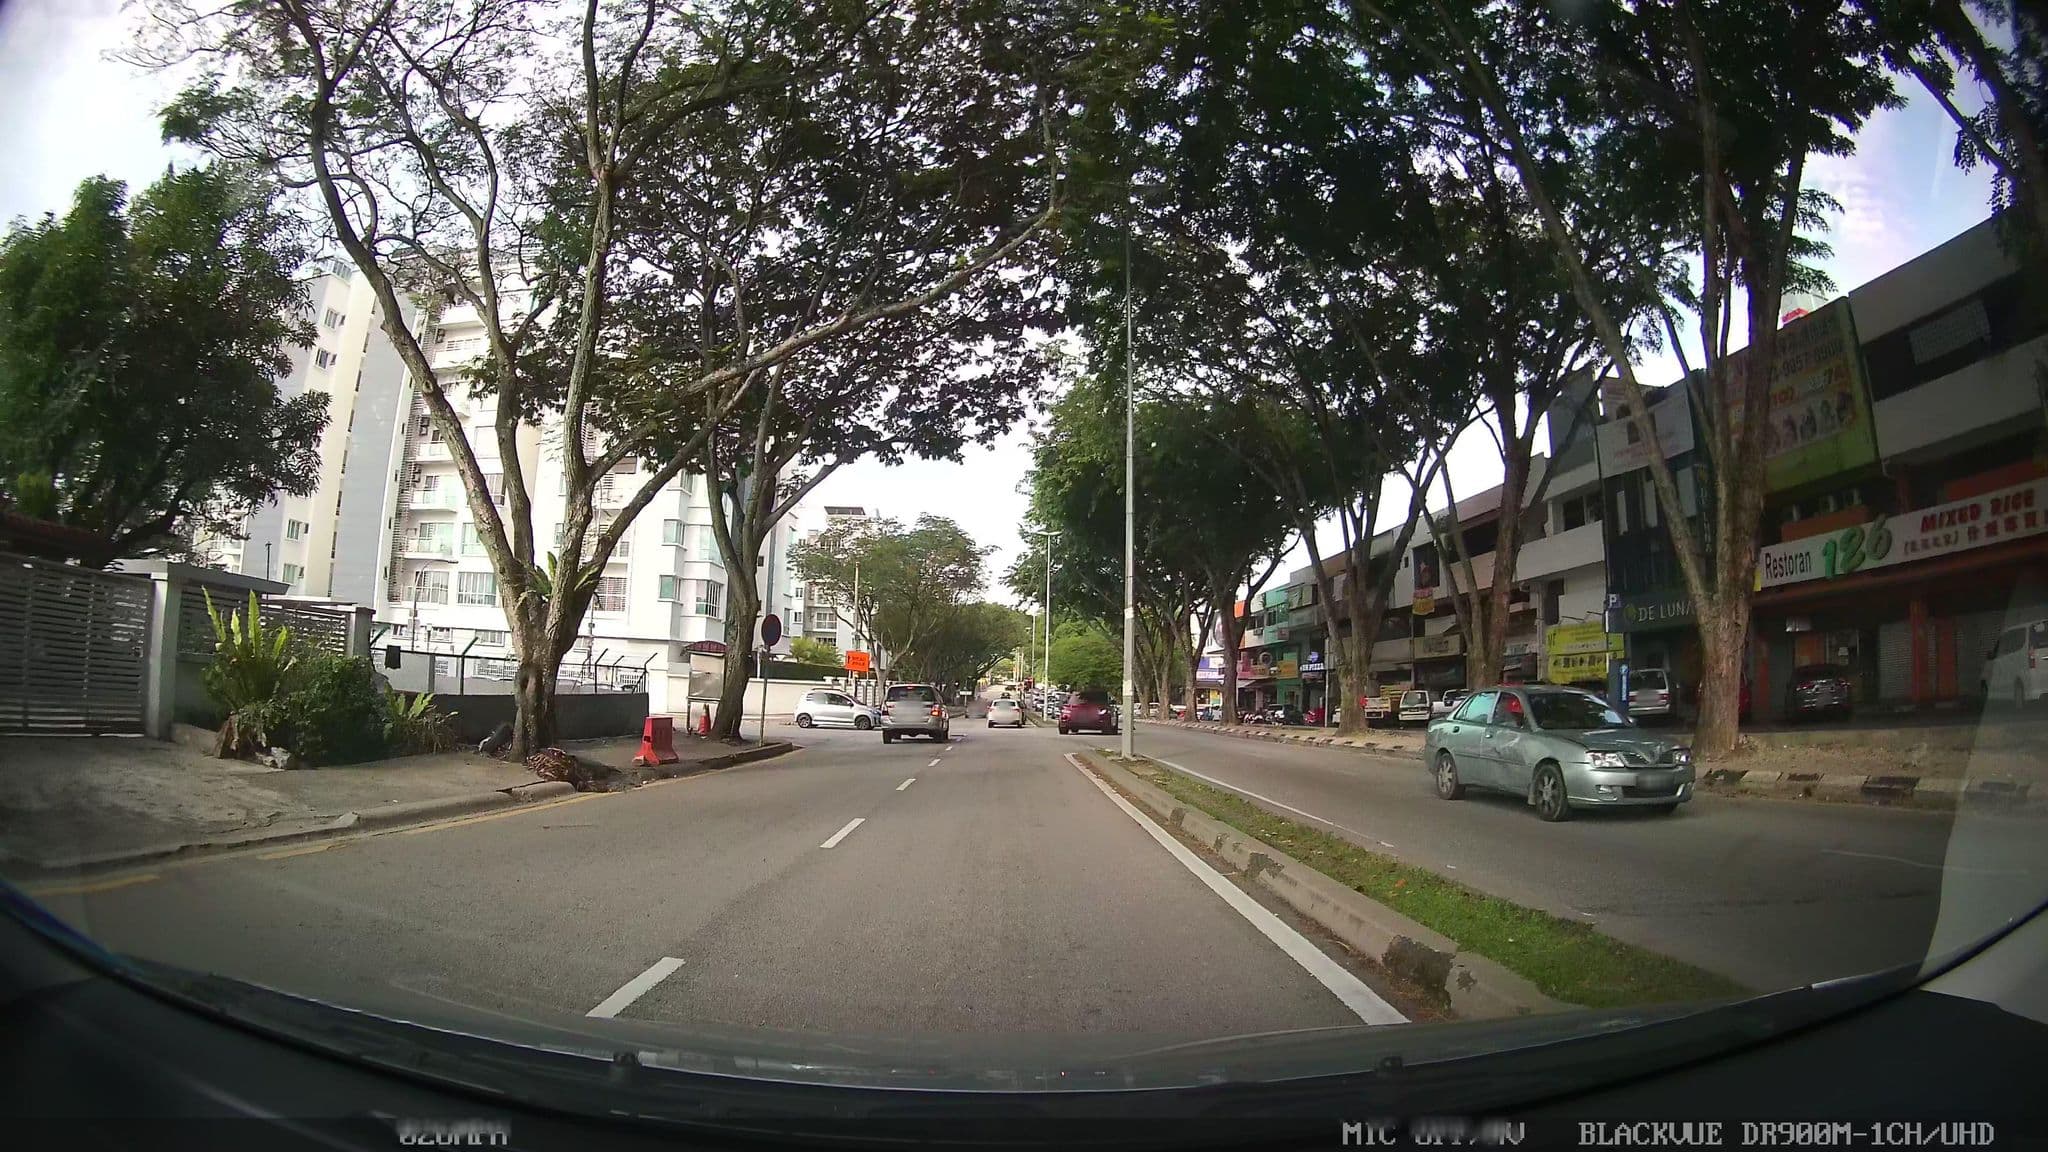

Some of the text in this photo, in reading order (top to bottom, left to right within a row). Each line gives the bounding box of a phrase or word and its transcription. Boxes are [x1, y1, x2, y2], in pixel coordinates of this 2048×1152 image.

[1921, 503, 1981, 533] MIXED
[1990, 488, 2035, 516] RICE
[1765, 550, 1812, 579] Restoran
[1823, 514, 1892, 578] 126
[1639, 605, 1657, 622] DE
